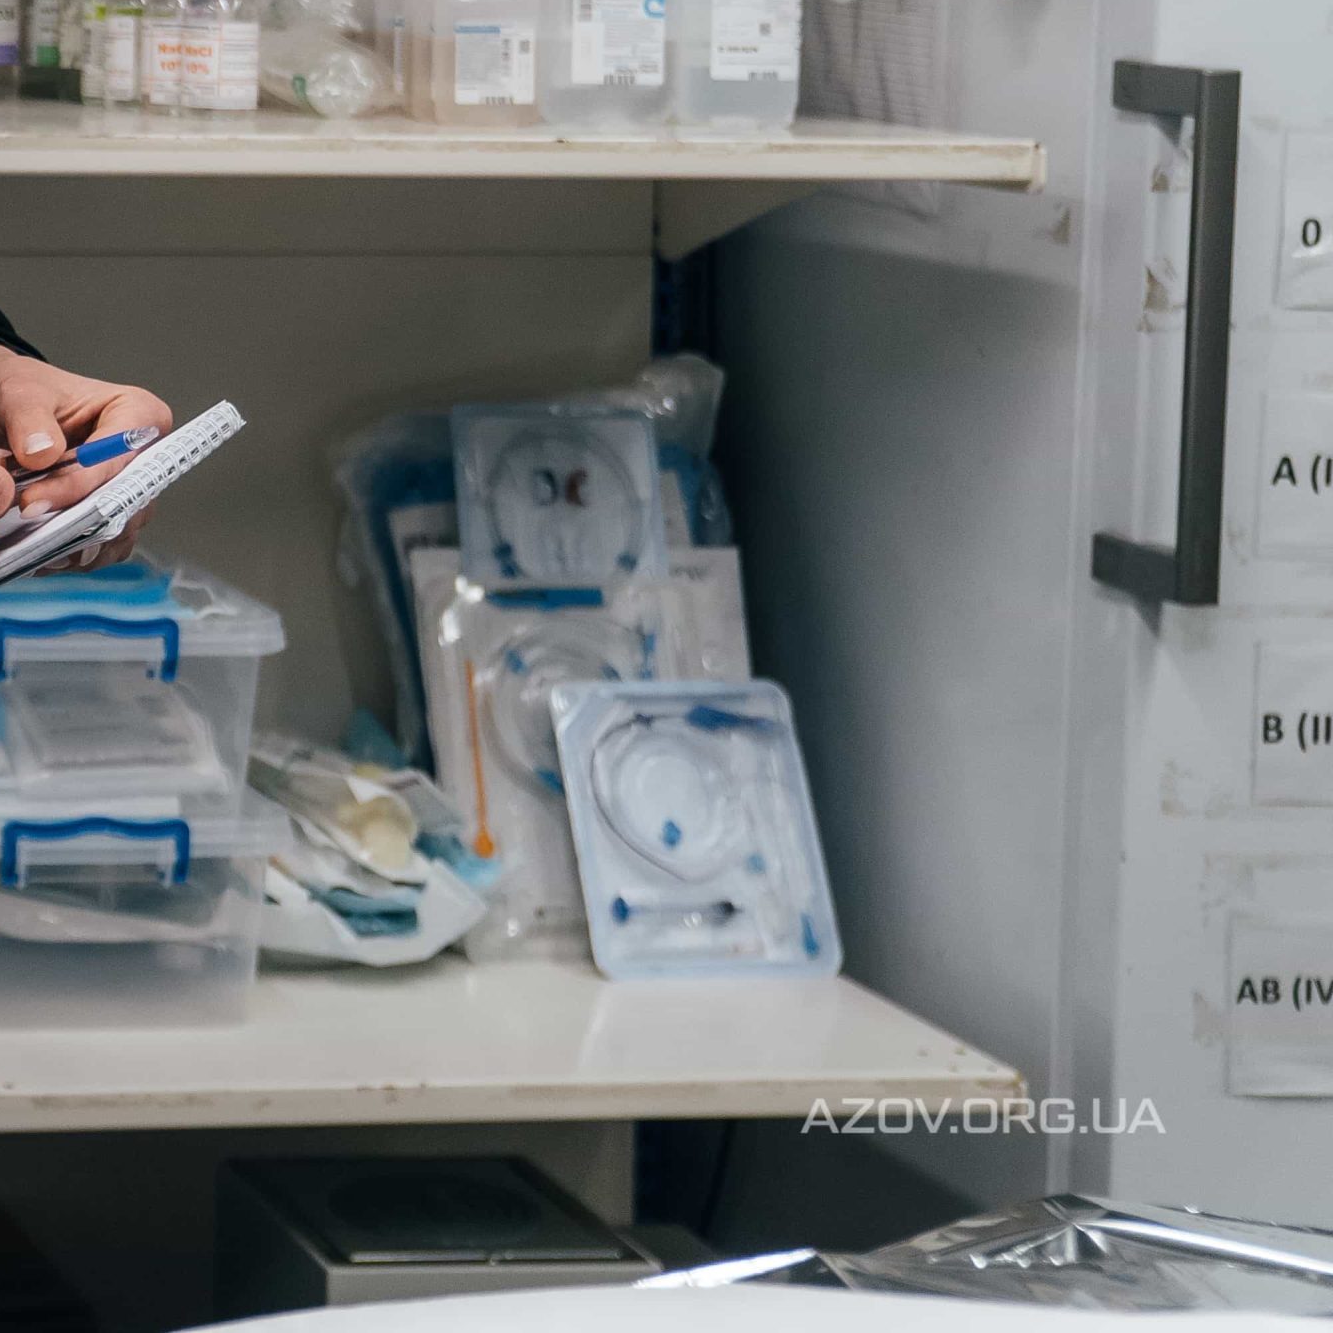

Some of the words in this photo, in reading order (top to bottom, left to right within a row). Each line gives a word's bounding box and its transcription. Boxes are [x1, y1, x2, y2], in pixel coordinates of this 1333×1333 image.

[1272, 456, 1297, 486] A
[1262, 714, 1283, 745] B
[1236, 979, 1281, 1005] AB
